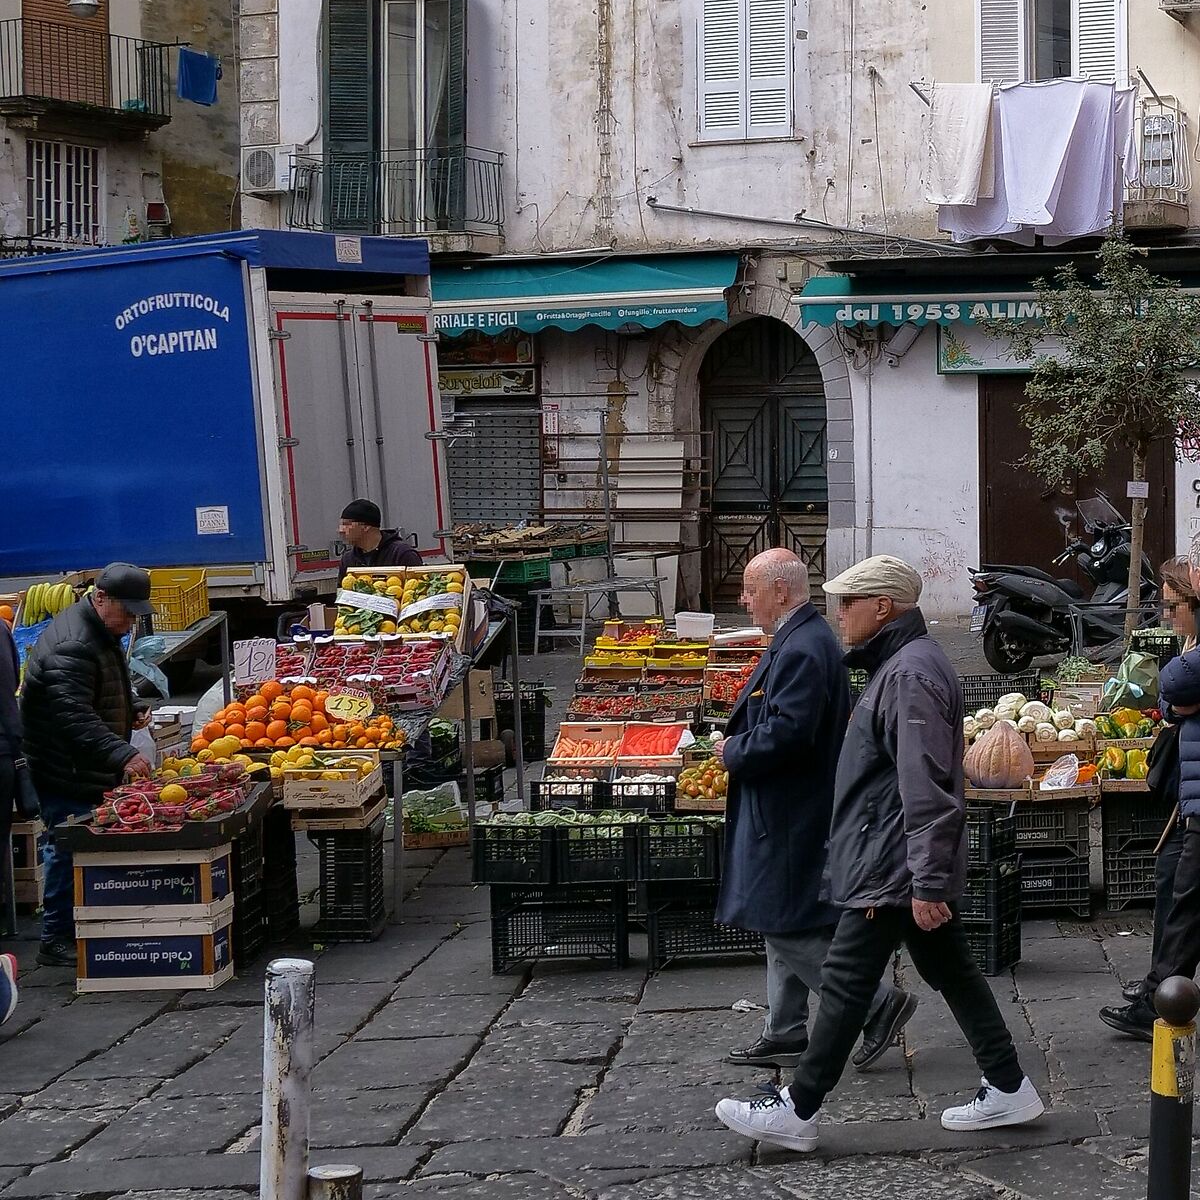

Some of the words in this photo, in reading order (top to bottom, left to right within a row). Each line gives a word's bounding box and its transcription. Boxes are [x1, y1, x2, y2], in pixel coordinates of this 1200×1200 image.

[115, 292, 230, 330] ORTOFRUTTICOLA
[835, 304, 879, 321] dal
[892, 302, 961, 321] 1953
[478, 312, 485, 327] E
[488, 311, 518, 327] FIGLI
[130, 328, 217, 358] O'CAPITAN
[438, 371, 502, 394] Surgelati
[93, 878, 149, 890] montagna
[151, 879, 162, 890] di
[164, 876, 195, 889] Mela
[94, 951, 148, 963] montagna
[149, 951, 160, 963] di
[161, 950, 193, 962] Mela
